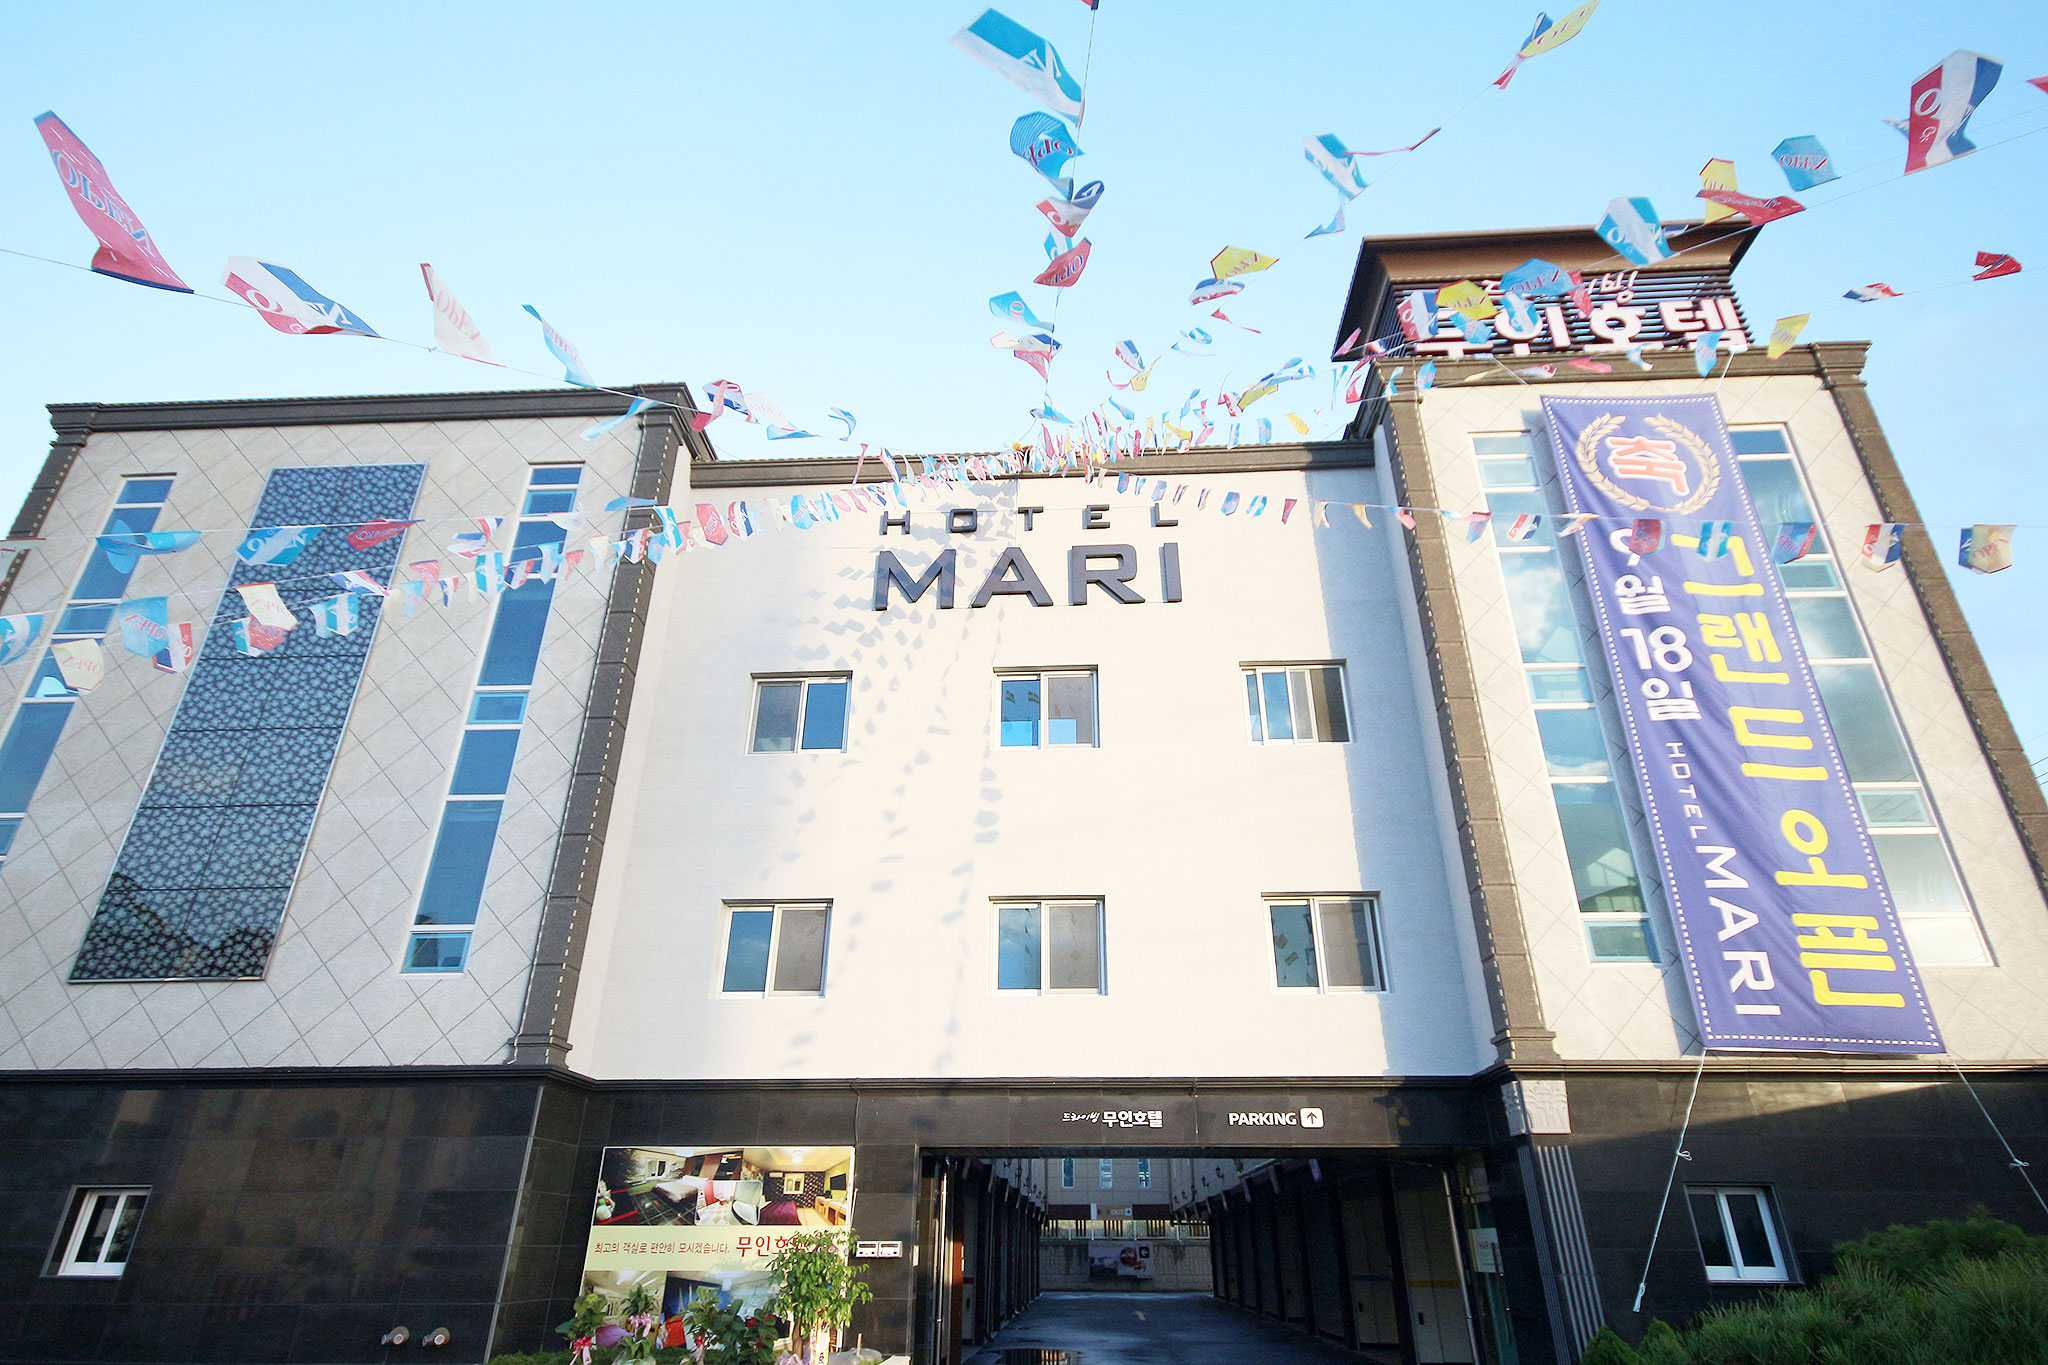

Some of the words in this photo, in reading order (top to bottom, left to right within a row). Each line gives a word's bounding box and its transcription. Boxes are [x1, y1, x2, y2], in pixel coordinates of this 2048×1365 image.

[1605, 434, 1690, 497] 축
[880, 502, 1179, 535] HOTEL
[872, 542, 1183, 611] MARI
[1666, 742, 1707, 838] HOTEL
[1696, 845, 1782, 1015] MARI
[1102, 1110, 1163, 1128] 무인호텔
[1229, 1112, 1297, 1126] PARKING
[594, 1242, 619, 1254] 최고의
[623, 1242, 648, 1254] 객실로
[651, 1242, 675, 1254] 편안히
